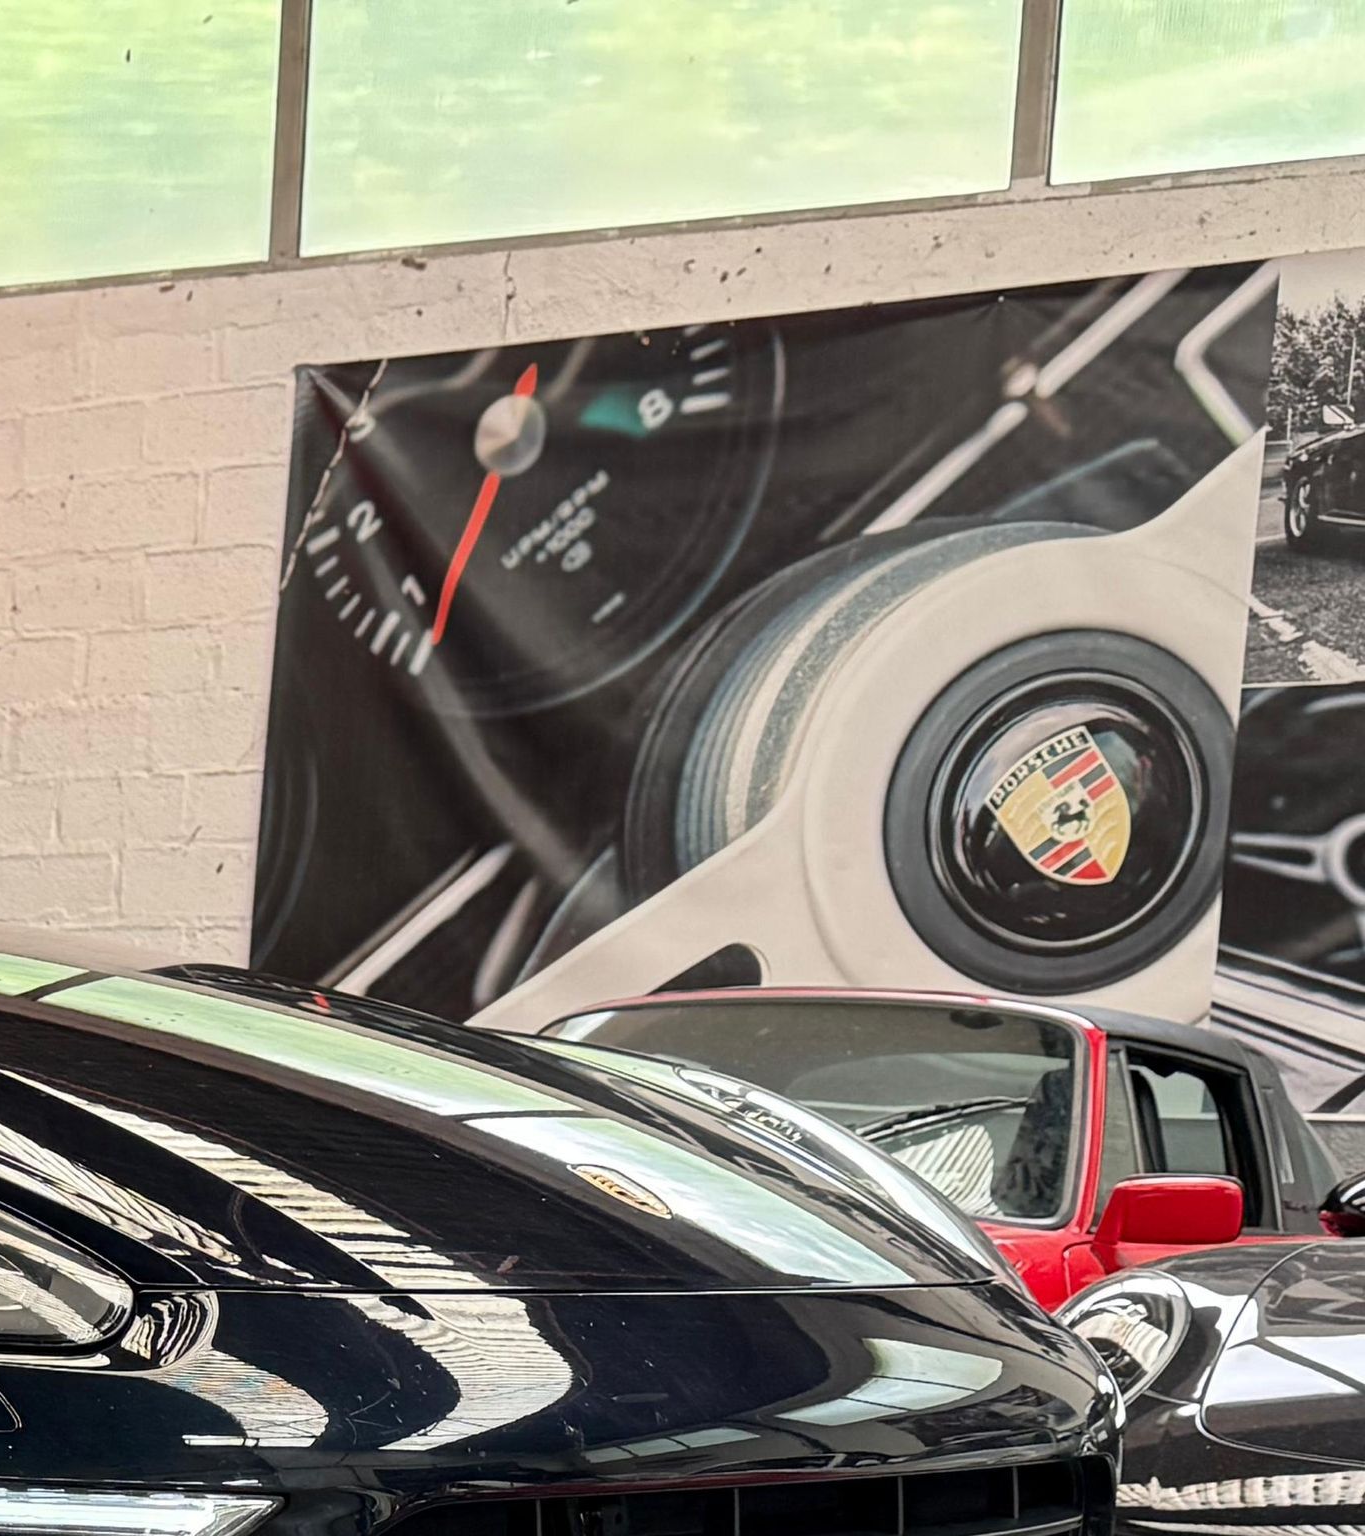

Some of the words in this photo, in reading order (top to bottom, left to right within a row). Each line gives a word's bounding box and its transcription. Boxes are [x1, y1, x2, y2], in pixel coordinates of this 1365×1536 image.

[637, 388, 672, 430] 8
[347, 499, 383, 544] 2
[401, 574, 427, 607] 1
[989, 729, 1090, 810] PORSCHE
